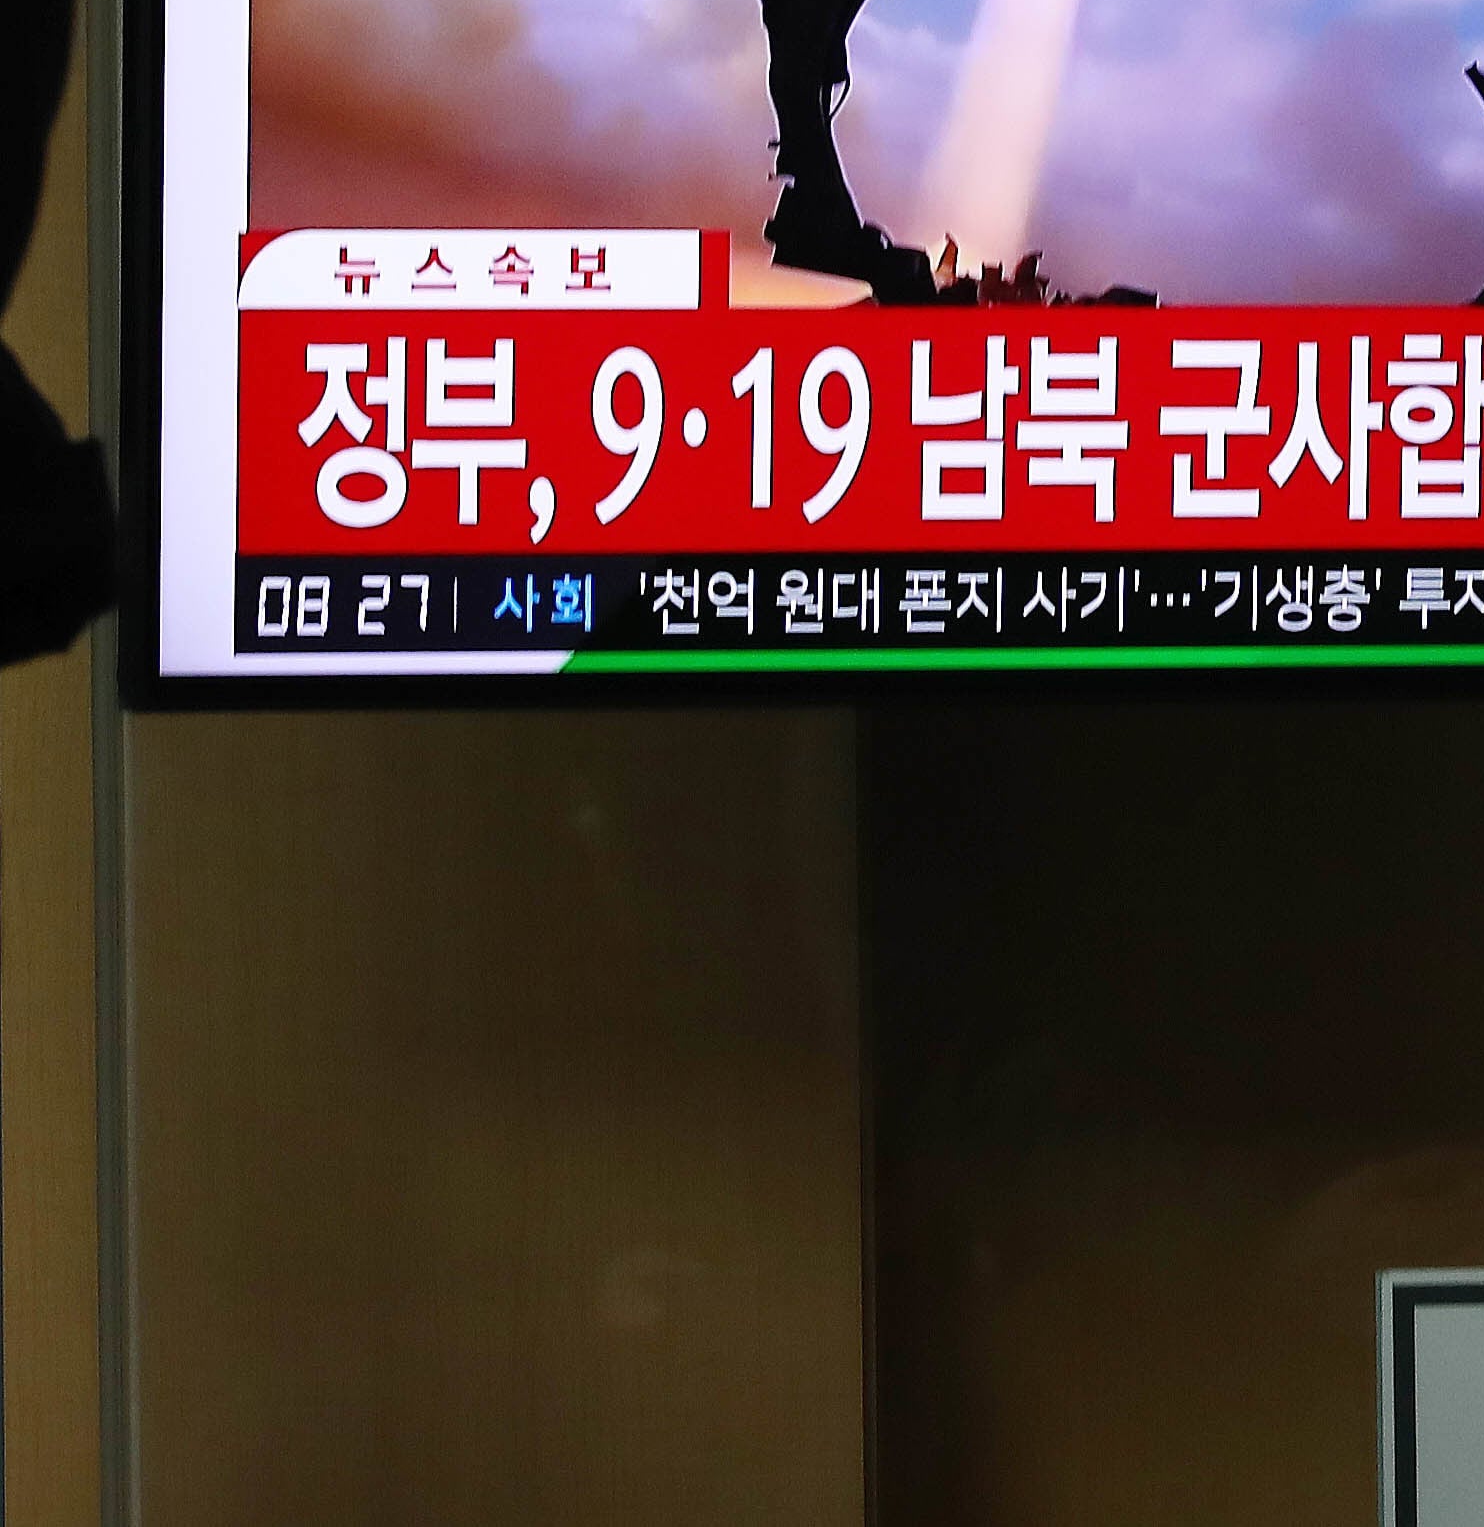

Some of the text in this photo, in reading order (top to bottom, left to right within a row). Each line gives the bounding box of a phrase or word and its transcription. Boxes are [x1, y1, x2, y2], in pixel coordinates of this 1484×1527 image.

[298, 336, 556, 544] 정부,
[911, 335, 1129, 523] 남북
[494, 573, 592, 634] 사회
[776, 568, 880, 634] 원대
[898, 567, 1003, 634] 폰지
